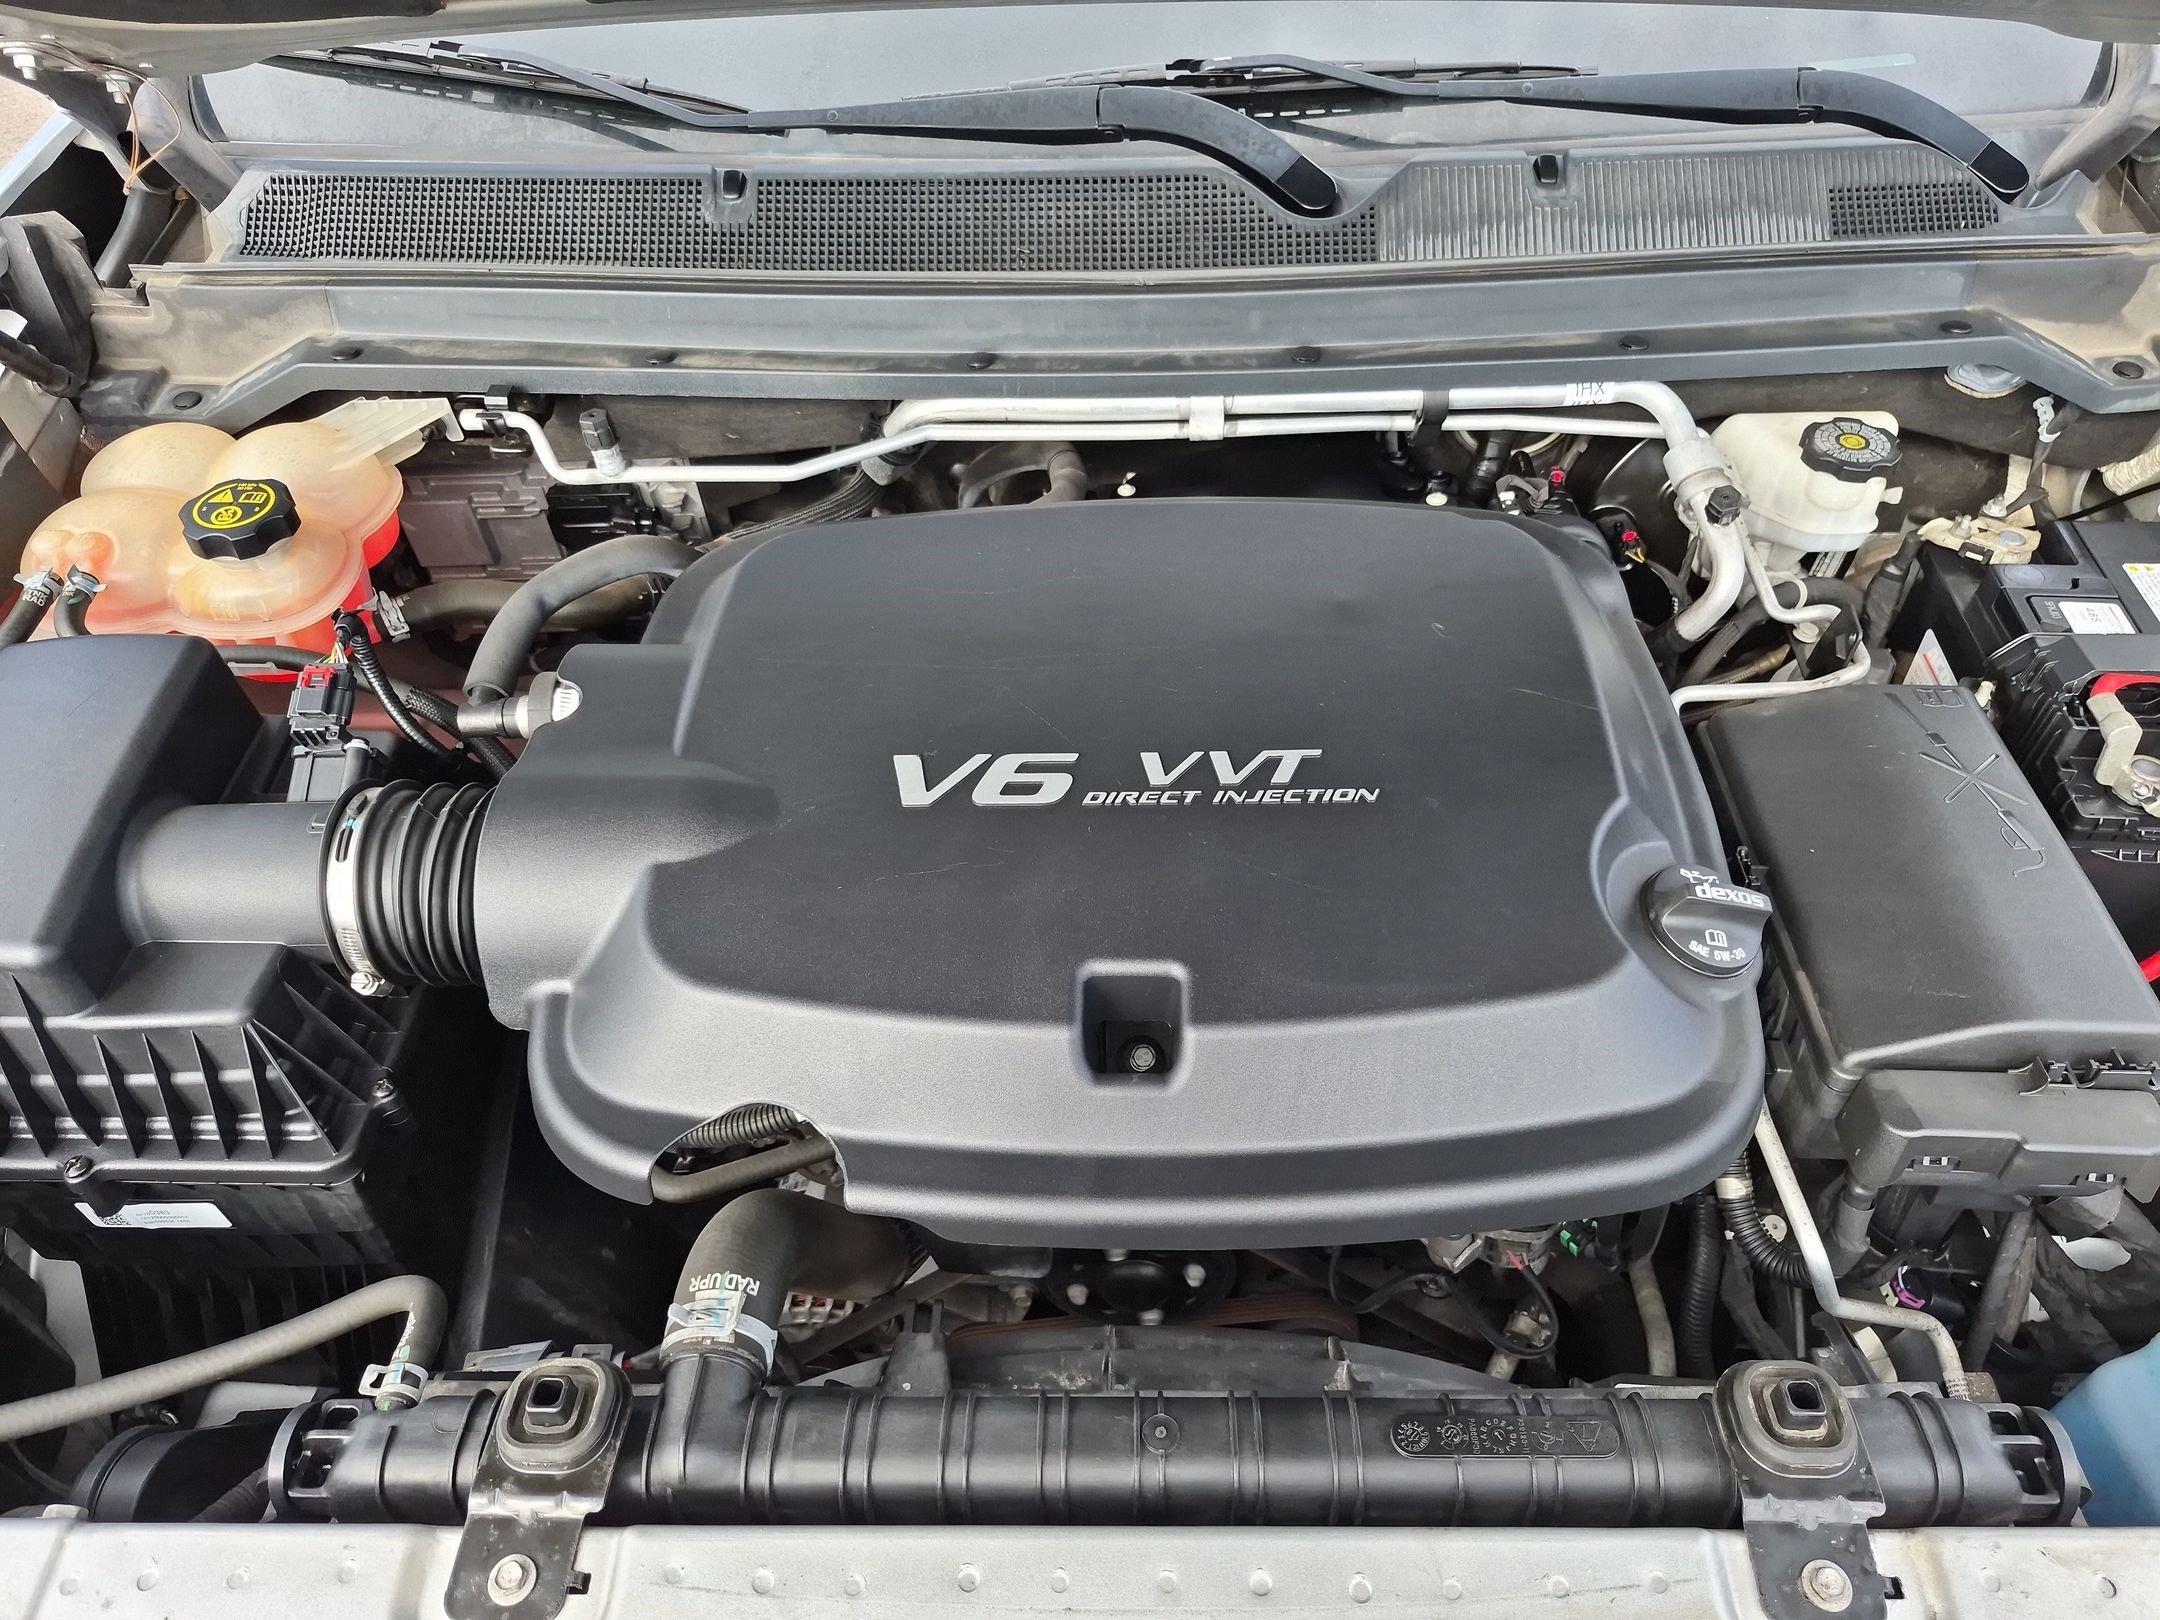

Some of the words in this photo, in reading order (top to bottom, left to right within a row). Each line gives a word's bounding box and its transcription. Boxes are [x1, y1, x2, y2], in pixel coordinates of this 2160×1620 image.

[22, 594, 46, 608] RAD
[1139, 748, 1323, 788] VVT
[893, 752, 1080, 808] V6
[1082, 790, 1204, 806] DIRECT
[1212, 788, 1380, 805] INJECTION
[1694, 882, 1765, 908] dexos
[1688, 940, 1710, 958] SAE
[1713, 947, 1746, 962] 5W-30
[689, 1272, 721, 1293] UPR
[725, 1273, 760, 1297] RAD
